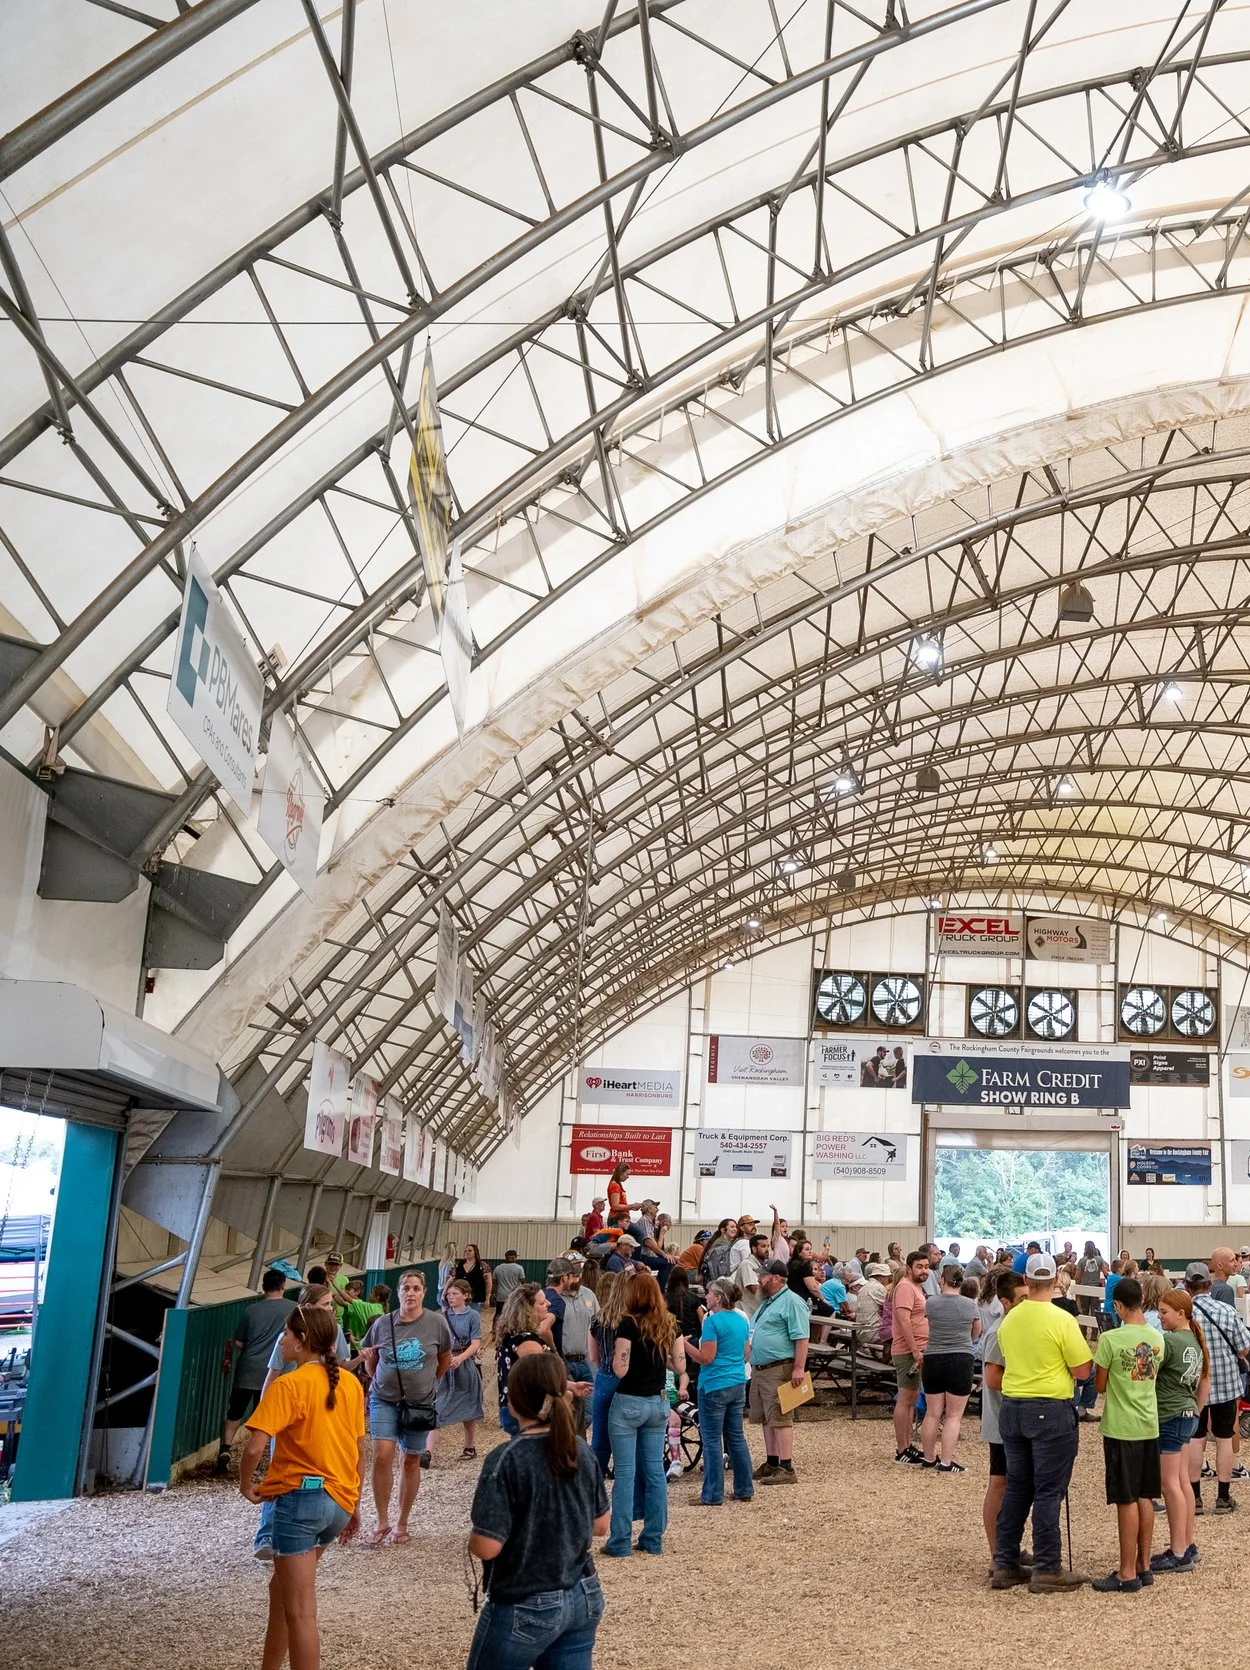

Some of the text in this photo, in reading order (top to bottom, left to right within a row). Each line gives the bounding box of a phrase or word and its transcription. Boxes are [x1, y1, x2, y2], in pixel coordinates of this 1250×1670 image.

[209, 644, 253, 755] PBMares
[202, 714, 247, 789] CPAs and Consultants
[938, 917, 1021, 935] EXCEL
[1033, 928, 1069, 936] HIGHWAY
[939, 934, 1019, 943] TRUCK GROUP
[1046, 935, 1079, 944] MOTORS
[821, 1045, 848, 1054] FARMER
[950, 1043, 960, 1051] The
[961, 1044, 998, 1054] Rockingham
[998, 1045, 1019, 1055] County
[1020, 1045, 1054, 1056] Fairgrounds
[1054, 1047, 1081, 1055] welcomes
[1100, 1048, 1110, 1056] the
[823, 1053, 847, 1063] FOCUS
[733, 1065, 788, 1076] Visit Rockingham
[981, 1069, 1103, 1089] FARM CREDIT
[602, 1079, 674, 1091] iHeartMEDIA
[980, 1090, 1080, 1105] SHOW RING B
[578, 1130, 623, 1140] Relationships
[624, 1131, 641, 1140] Built
[650, 1132, 666, 1140] Last
[698, 1132, 719, 1140] Truck
[728, 1133, 768, 1141] Equipment
[769, 1134, 790, 1142] Corp.
[816, 1134, 856, 1143] BIG RED'S
[720, 1141, 768, 1150] 540-434-2557
[816, 1143, 847, 1151] POWER
[585, 1149, 633, 1159] First Bank
[634, 1157, 663, 1165] Company
[833, 1166, 887, 1176] (540)908-8509
